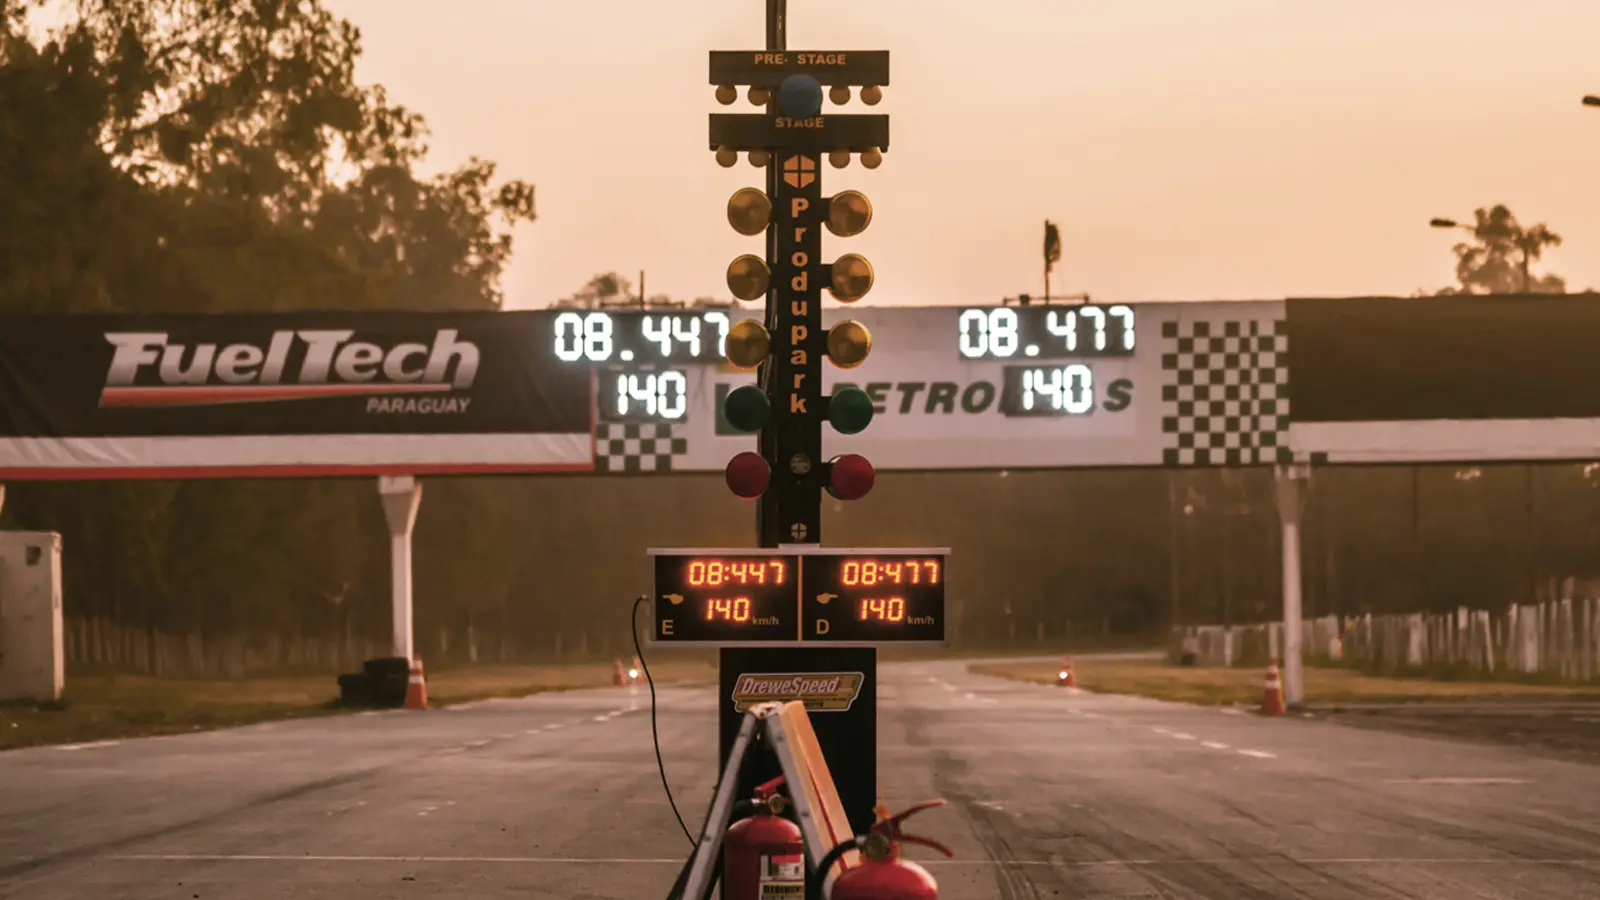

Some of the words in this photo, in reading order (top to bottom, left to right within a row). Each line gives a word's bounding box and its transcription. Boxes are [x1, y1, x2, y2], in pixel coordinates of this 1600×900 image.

[797, 53, 847, 65] STAGE
[775, 117, 825, 129] STAGE
[790, 197, 809, 413] Produpark
[554, 312, 729, 362] 08.447
[958, 305, 1135, 358] 08.477
[104, 329, 480, 390] FuelTech
[617, 370, 686, 419] 140
[832, 379, 1134, 415] ETROS
[1022, 364, 1092, 414] 140
[366, 397, 472, 415] PARAGUAY
[688, 561, 785, 586] 08:447
[842, 561, 939, 586] 08:477
[706, 597, 750, 622] 140
[752, 615, 779, 626] km/h
[860, 597, 905, 622] 140
[907, 615, 935, 626] km/h
[662, 619, 674, 635] E
[816, 619, 830, 635] D
[742, 676, 840, 697] DreweSpeed
